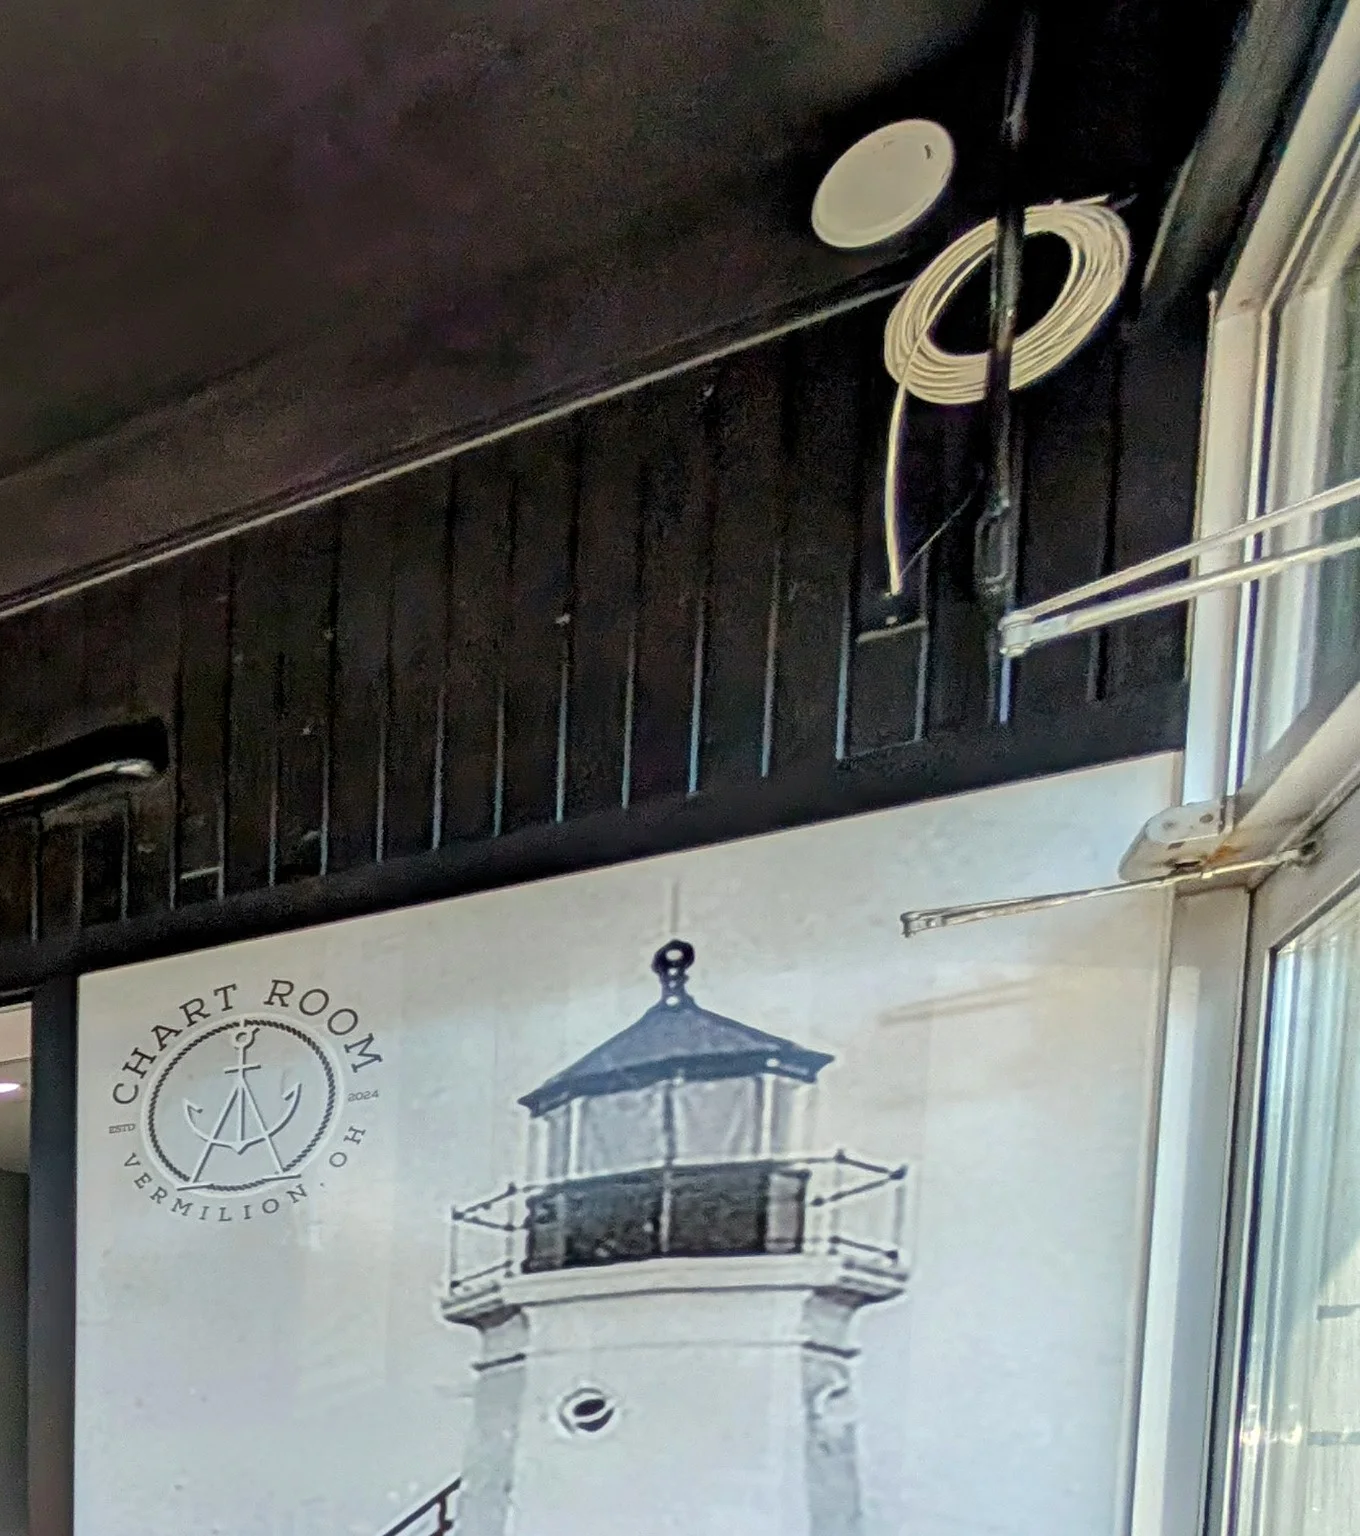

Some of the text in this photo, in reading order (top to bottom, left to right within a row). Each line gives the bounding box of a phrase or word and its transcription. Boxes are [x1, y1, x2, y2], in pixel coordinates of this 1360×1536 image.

[112, 979, 383, 1105] CHART ROOM
[347, 1090, 379, 1102] 2024
[108, 1122, 136, 1134] ESTD
[329, 1126, 367, 1198] OH
